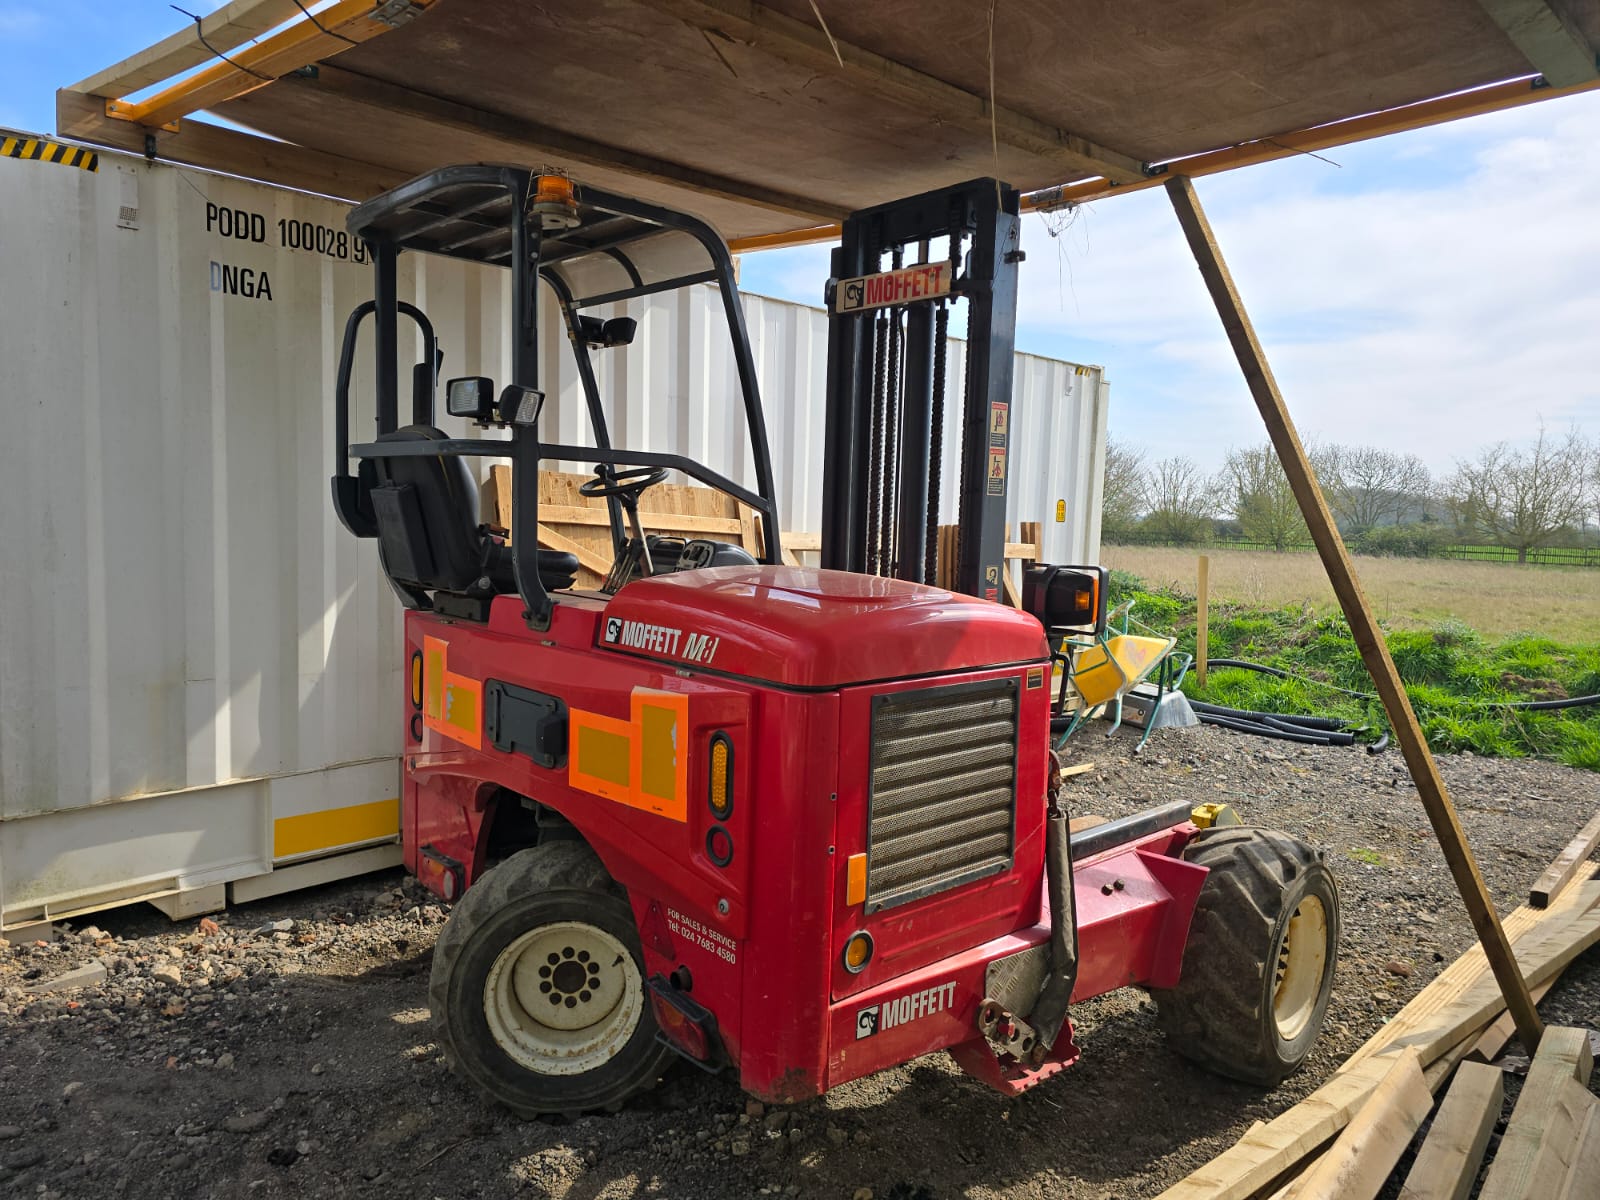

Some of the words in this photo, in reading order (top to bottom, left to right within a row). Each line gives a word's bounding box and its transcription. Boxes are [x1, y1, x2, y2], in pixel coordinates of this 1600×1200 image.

[206, 201, 266, 243] PODD
[209, 260, 273, 301] DNGA
[866, 265, 943, 305] MOFFETT
[621, 620, 682, 655] MOFFETT
[667, 908, 680, 921] FOR
[681, 915, 701, 932] SALES
[702, 925, 708, 935] &
[708, 929, 736, 951] SERVICE
[681, 927, 695, 942] 024
[696, 935, 715, 953] 7683
[716, 946, 736, 965] 4580
[881, 980, 957, 1031] MOFFETT
